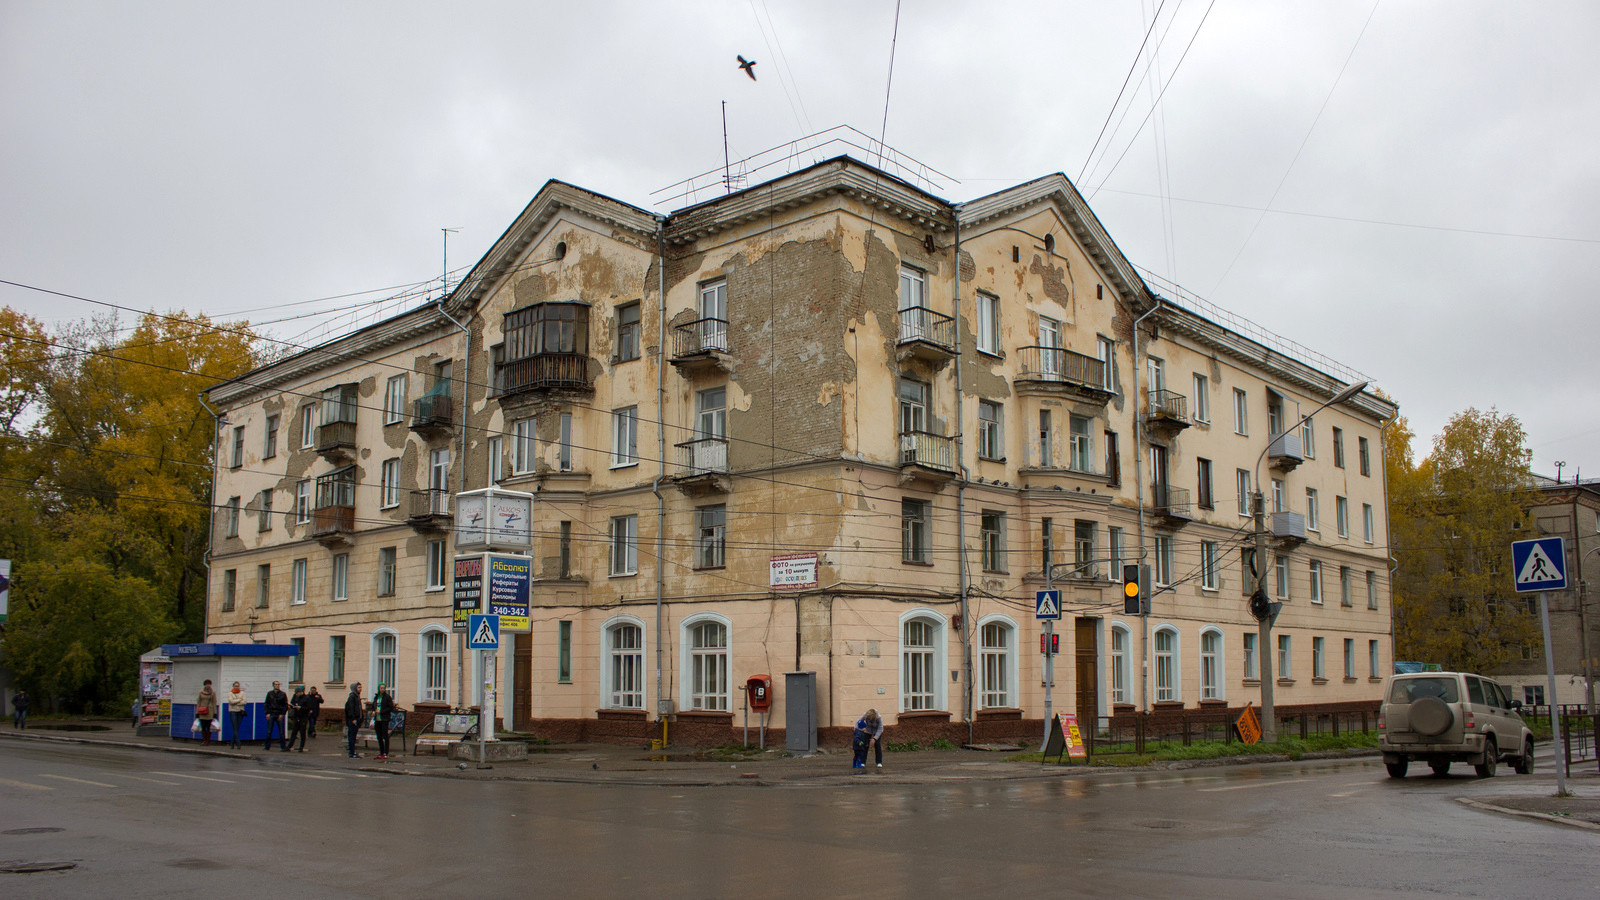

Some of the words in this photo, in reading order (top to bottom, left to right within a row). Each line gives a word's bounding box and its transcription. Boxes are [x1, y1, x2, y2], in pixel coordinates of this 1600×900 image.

[455, 560, 481, 578] КВАРТИРЫ
[492, 561, 529, 573] Абсолют
[492, 572, 527, 580] Контрольные
[492, 579, 519, 587] Рефераты
[492, 586, 517, 594] Курсовые
[492, 593, 517, 601] Дипломы
[493, 606, 526, 616] 340-342
